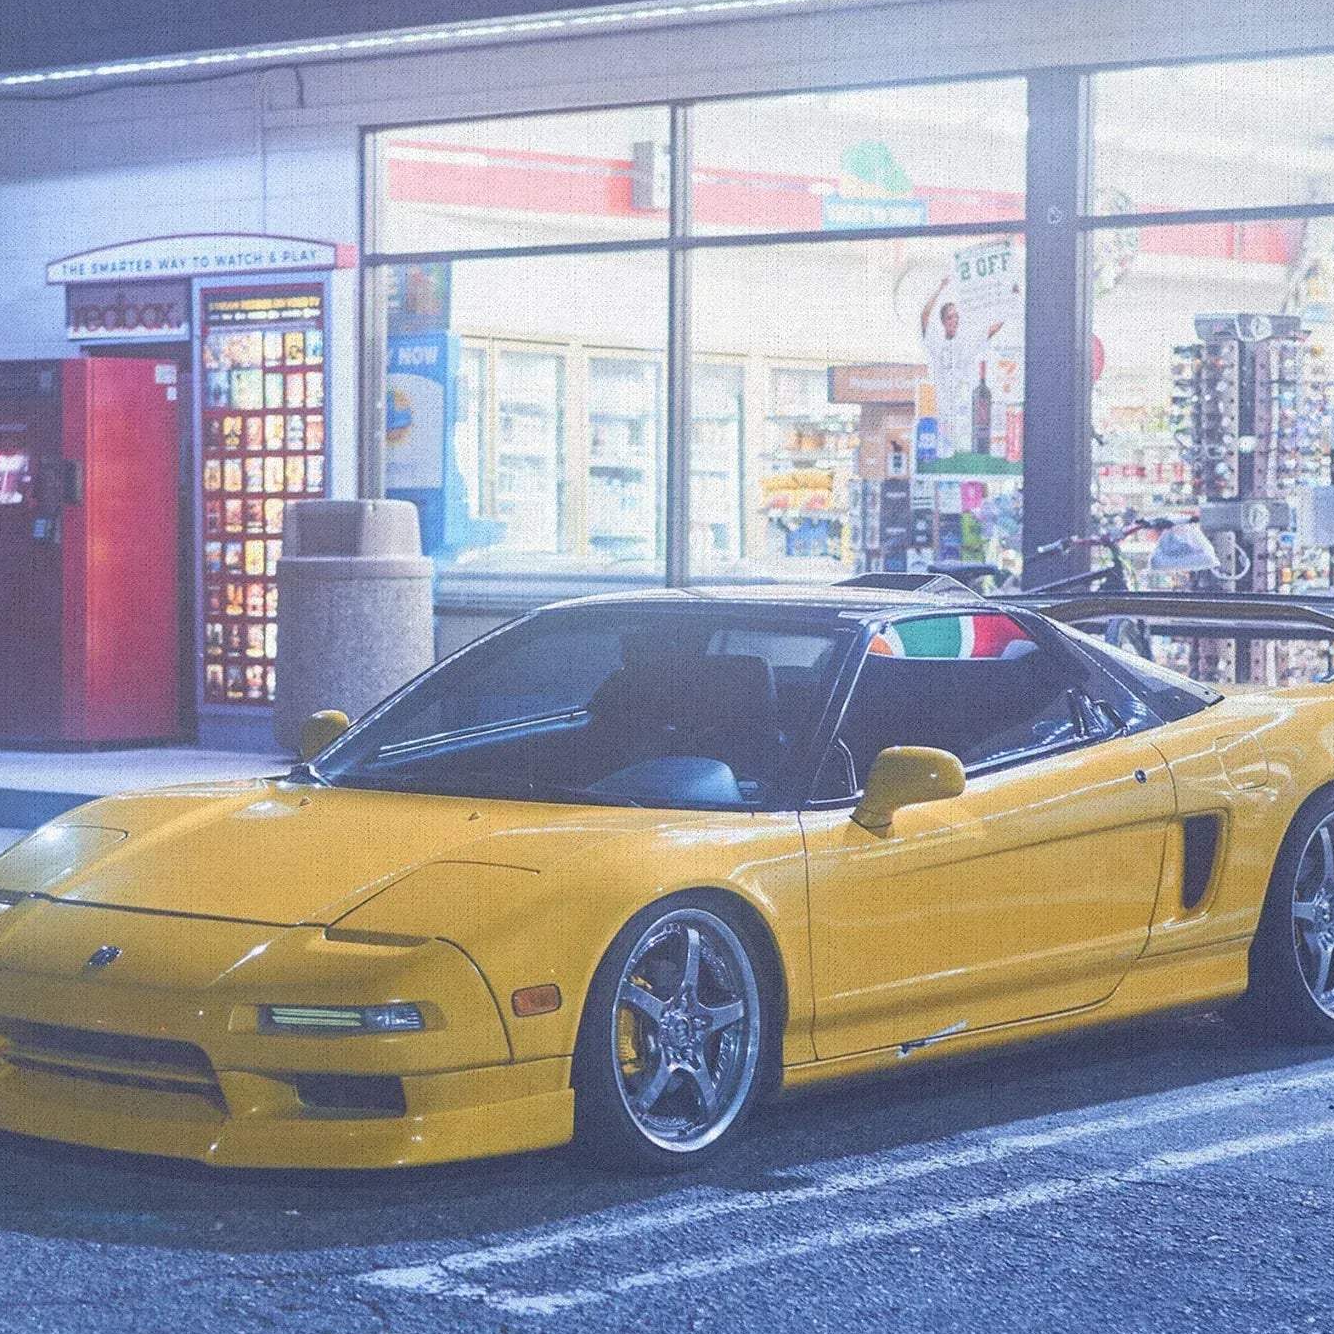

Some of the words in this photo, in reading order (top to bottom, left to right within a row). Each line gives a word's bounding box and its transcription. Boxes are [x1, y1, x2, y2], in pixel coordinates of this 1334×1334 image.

[62, 263, 85, 276] THE
[91, 259, 152, 275] SMARTER
[158, 257, 187, 271] WAY
[192, 255, 209, 269] TO
[215, 253, 262, 268] WATCH
[269, 251, 278, 264] &
[282, 250, 317, 264] PLAY
[976, 252, 1012, 278] OFF
[72, 292, 183, 332] redbox
[398, 345, 440, 365] NOW
